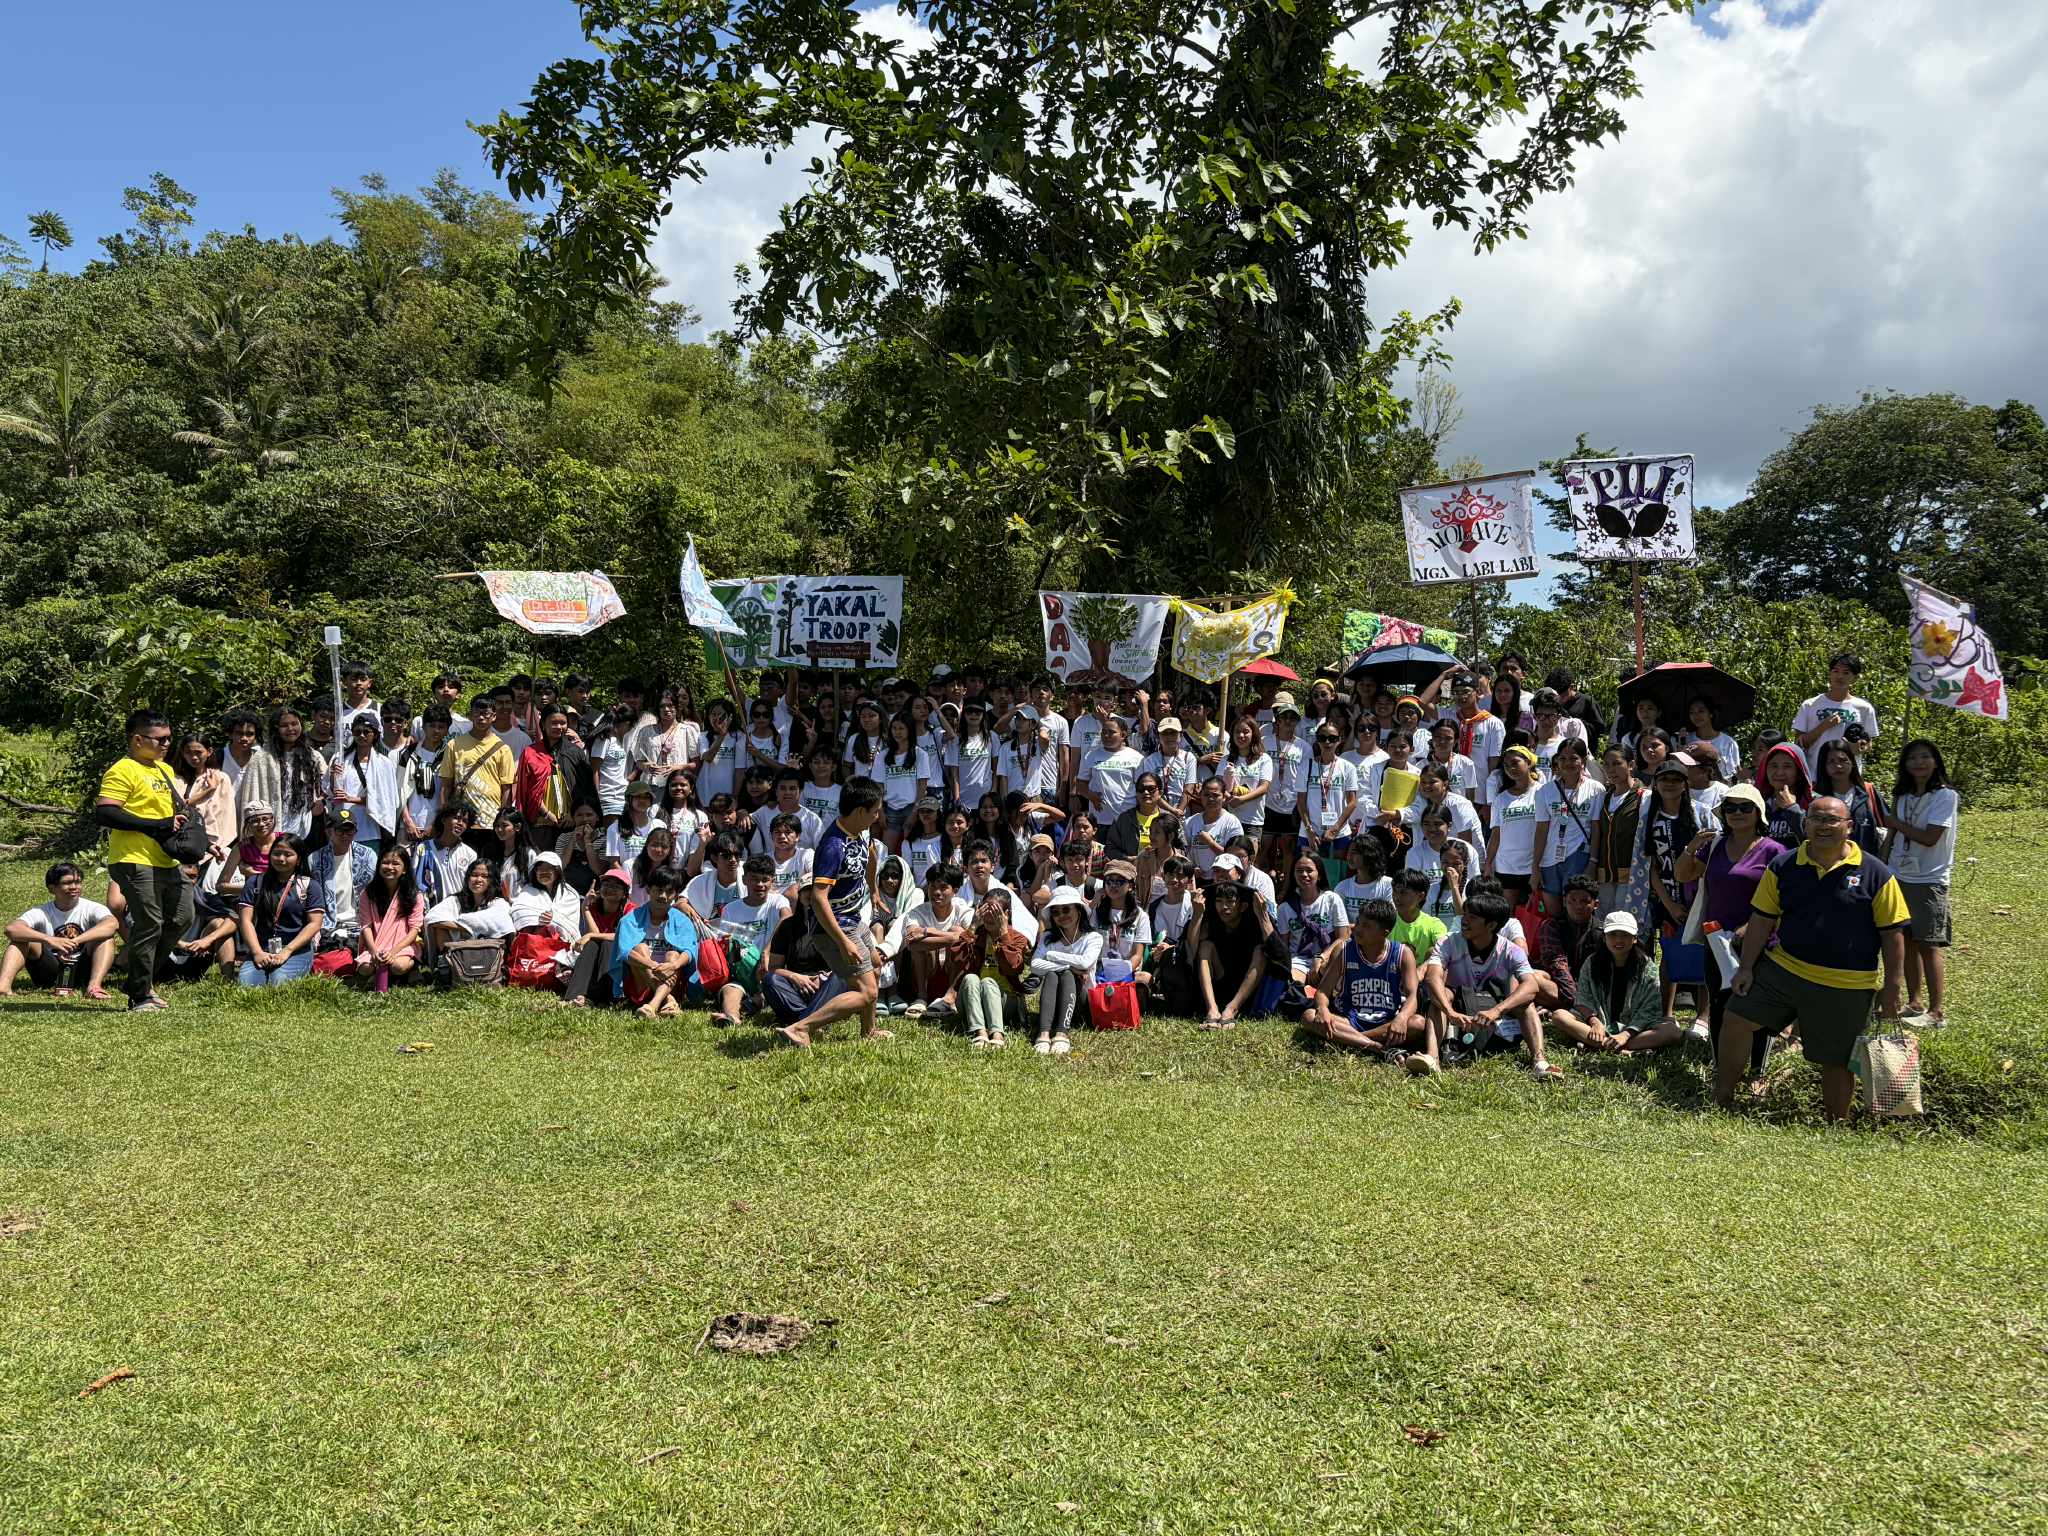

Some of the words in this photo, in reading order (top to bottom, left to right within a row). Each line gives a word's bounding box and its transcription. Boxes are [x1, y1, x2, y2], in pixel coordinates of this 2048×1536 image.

[1590, 463, 1676, 505] PILI
[1427, 521, 1511, 552] MOLAVE
[1415, 566, 1449, 581] MGA
[1463, 561, 1495, 578] LABI
[1500, 556, 1534, 573] LABI
[805, 594, 886, 617] YAKAL
[803, 617, 871, 640] TROOP
[1351, 993, 1395, 1010] SIXERS
